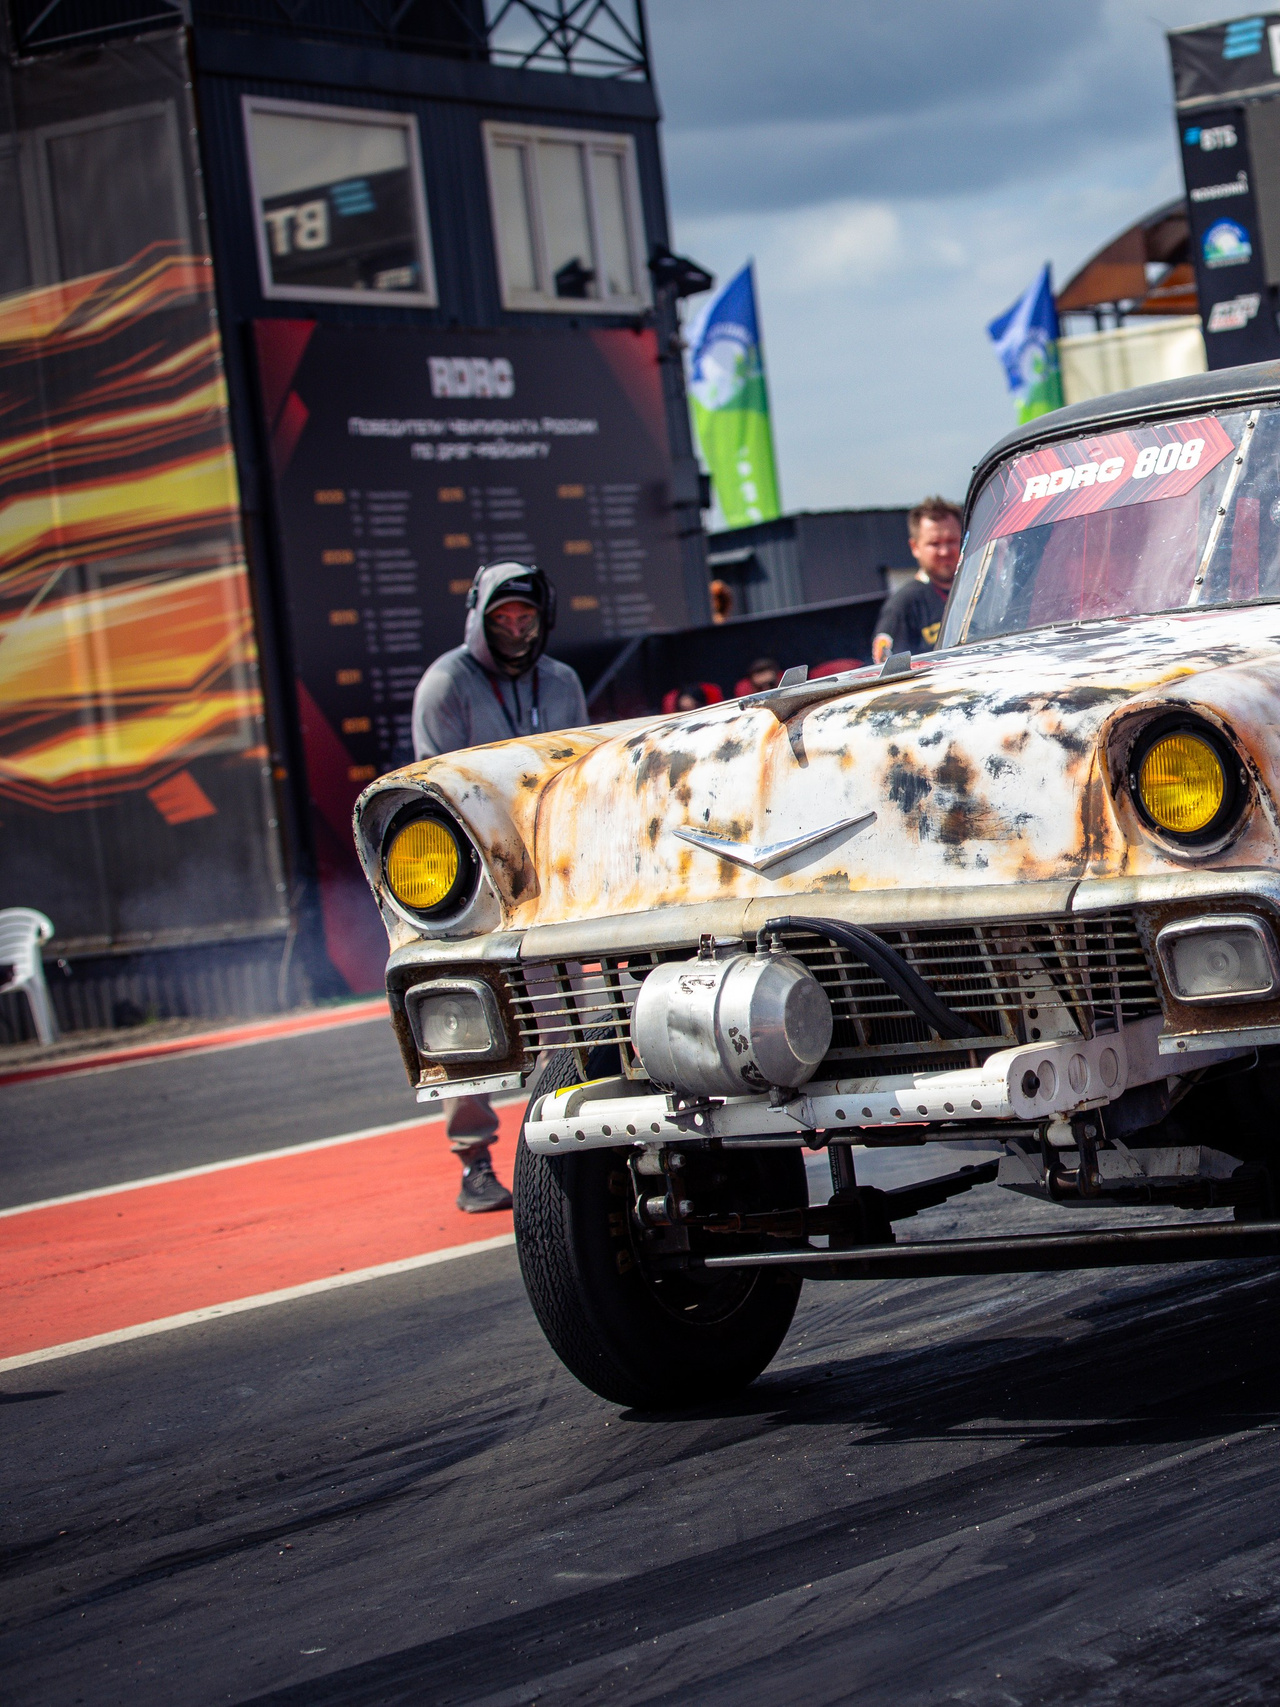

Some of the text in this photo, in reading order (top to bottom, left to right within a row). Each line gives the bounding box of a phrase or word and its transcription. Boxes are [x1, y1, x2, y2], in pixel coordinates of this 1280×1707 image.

[427, 356, 515, 398] RDRC
[1021, 437, 1206, 503] RDRC 808
